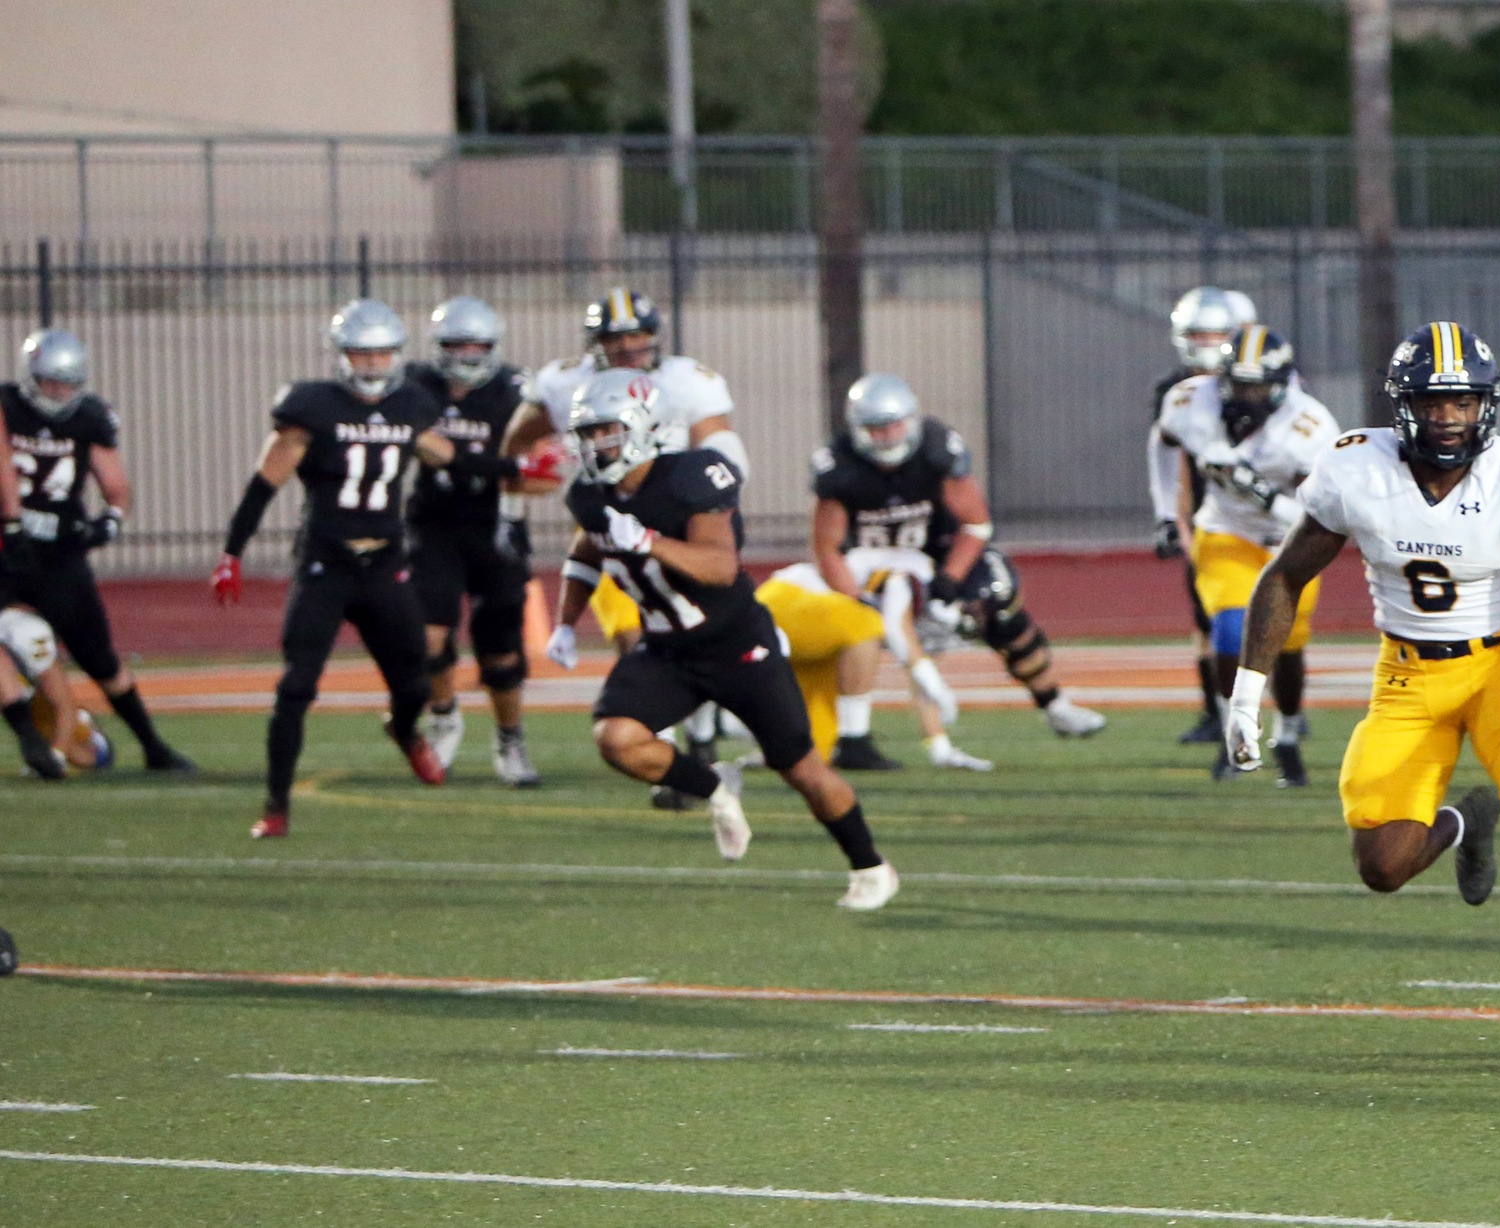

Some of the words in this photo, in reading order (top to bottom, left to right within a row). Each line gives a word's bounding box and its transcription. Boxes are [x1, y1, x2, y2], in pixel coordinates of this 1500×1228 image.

[335, 422, 413, 444] PALOMAR
[1335, 434, 1367, 449] 6
[338, 443, 401, 512] 11
[704, 461, 736, 490] 21
[1397, 540, 1463, 557] CANYONS
[1403, 558, 1460, 614] 6
